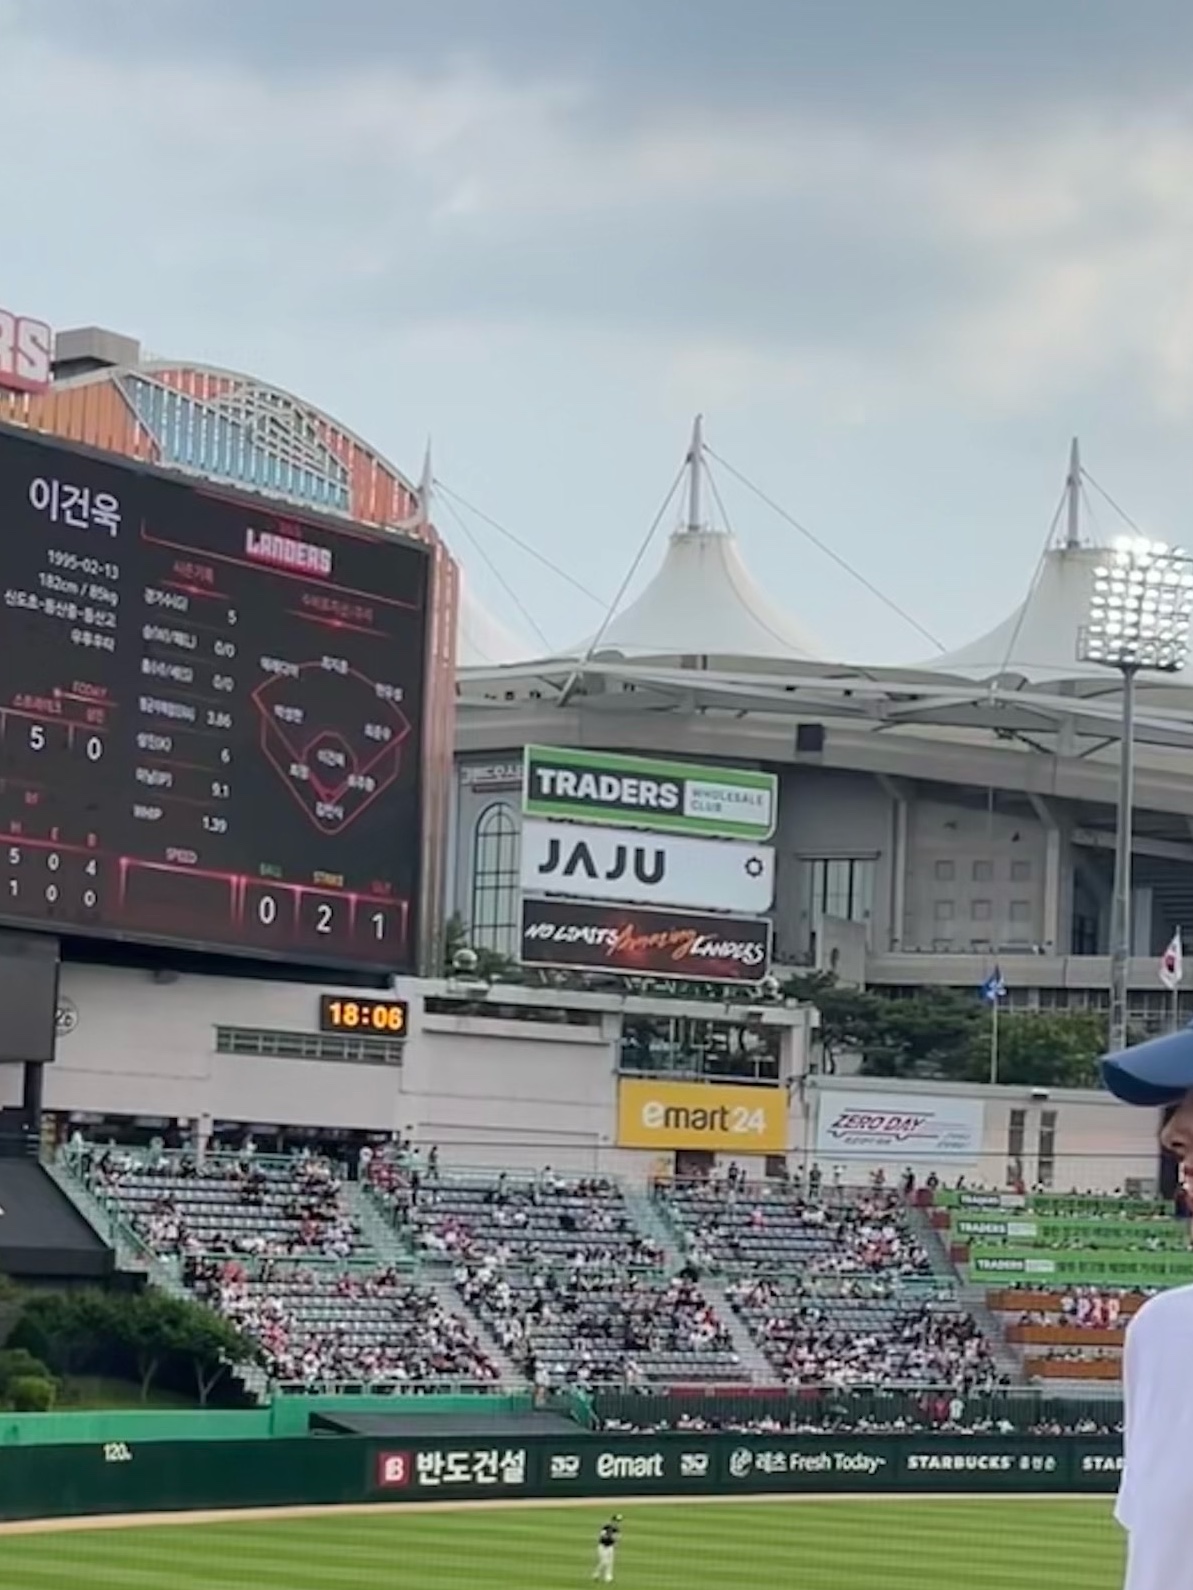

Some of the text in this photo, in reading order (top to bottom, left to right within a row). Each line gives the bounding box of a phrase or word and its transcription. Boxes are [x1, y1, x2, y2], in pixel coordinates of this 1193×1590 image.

[30, 477, 121, 537] 이건욱
[246, 527, 332, 574] LANDERS
[30, 725, 103, 760] 5 0
[536, 768, 679, 809] TRADERS
[692, 789, 764, 806] WHOLESALE
[692, 801, 722, 813] CLUB
[9, 847, 97, 876] 5 0 4
[538, 839, 666, 885] JAJU
[9, 880, 96, 907] 1 0 0
[258, 896, 384, 940] 0 2 1
[329, 1003, 403, 1031] 18:06
[642, 1101, 767, 1133] emart24
[832, 1114, 926, 1131] ZERO DAY
[959, 1221, 1006, 1234] TRADERS
[977, 1258, 1024, 1270] TRADERS
[416, 1450, 527, 1486] 반도건설
[597, 1452, 664, 1478] emart
[790, 1452, 832, 1471] Fresh
[834, 1452, 878, 1475] Today
[907, 1455, 1012, 1470] STARBUCKS
